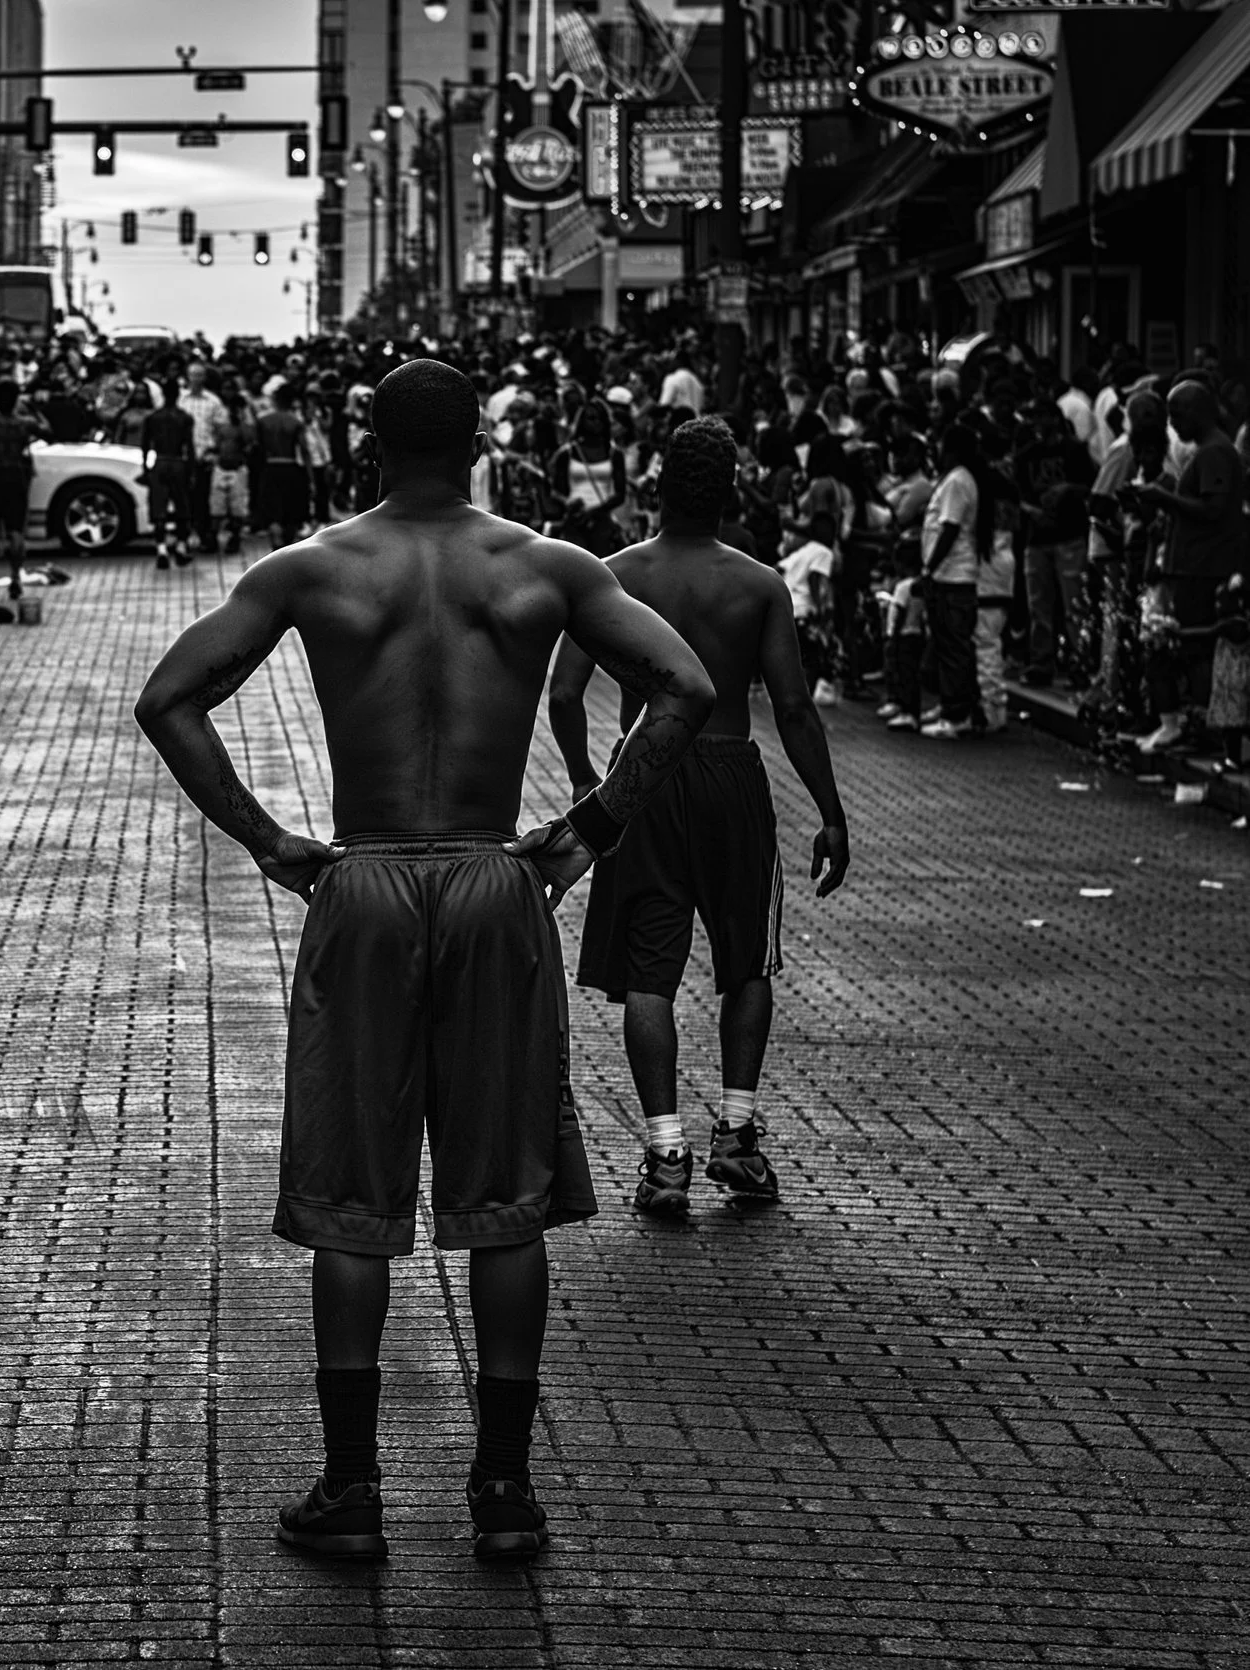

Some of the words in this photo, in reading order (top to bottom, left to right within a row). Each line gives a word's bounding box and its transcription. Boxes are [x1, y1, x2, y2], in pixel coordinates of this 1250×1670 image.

[752, 78, 847, 98] GENERAL
[878, 76, 952, 98] BEALE
[958, 74, 1043, 97] STREET
[769, 94, 832, 110] STORE
